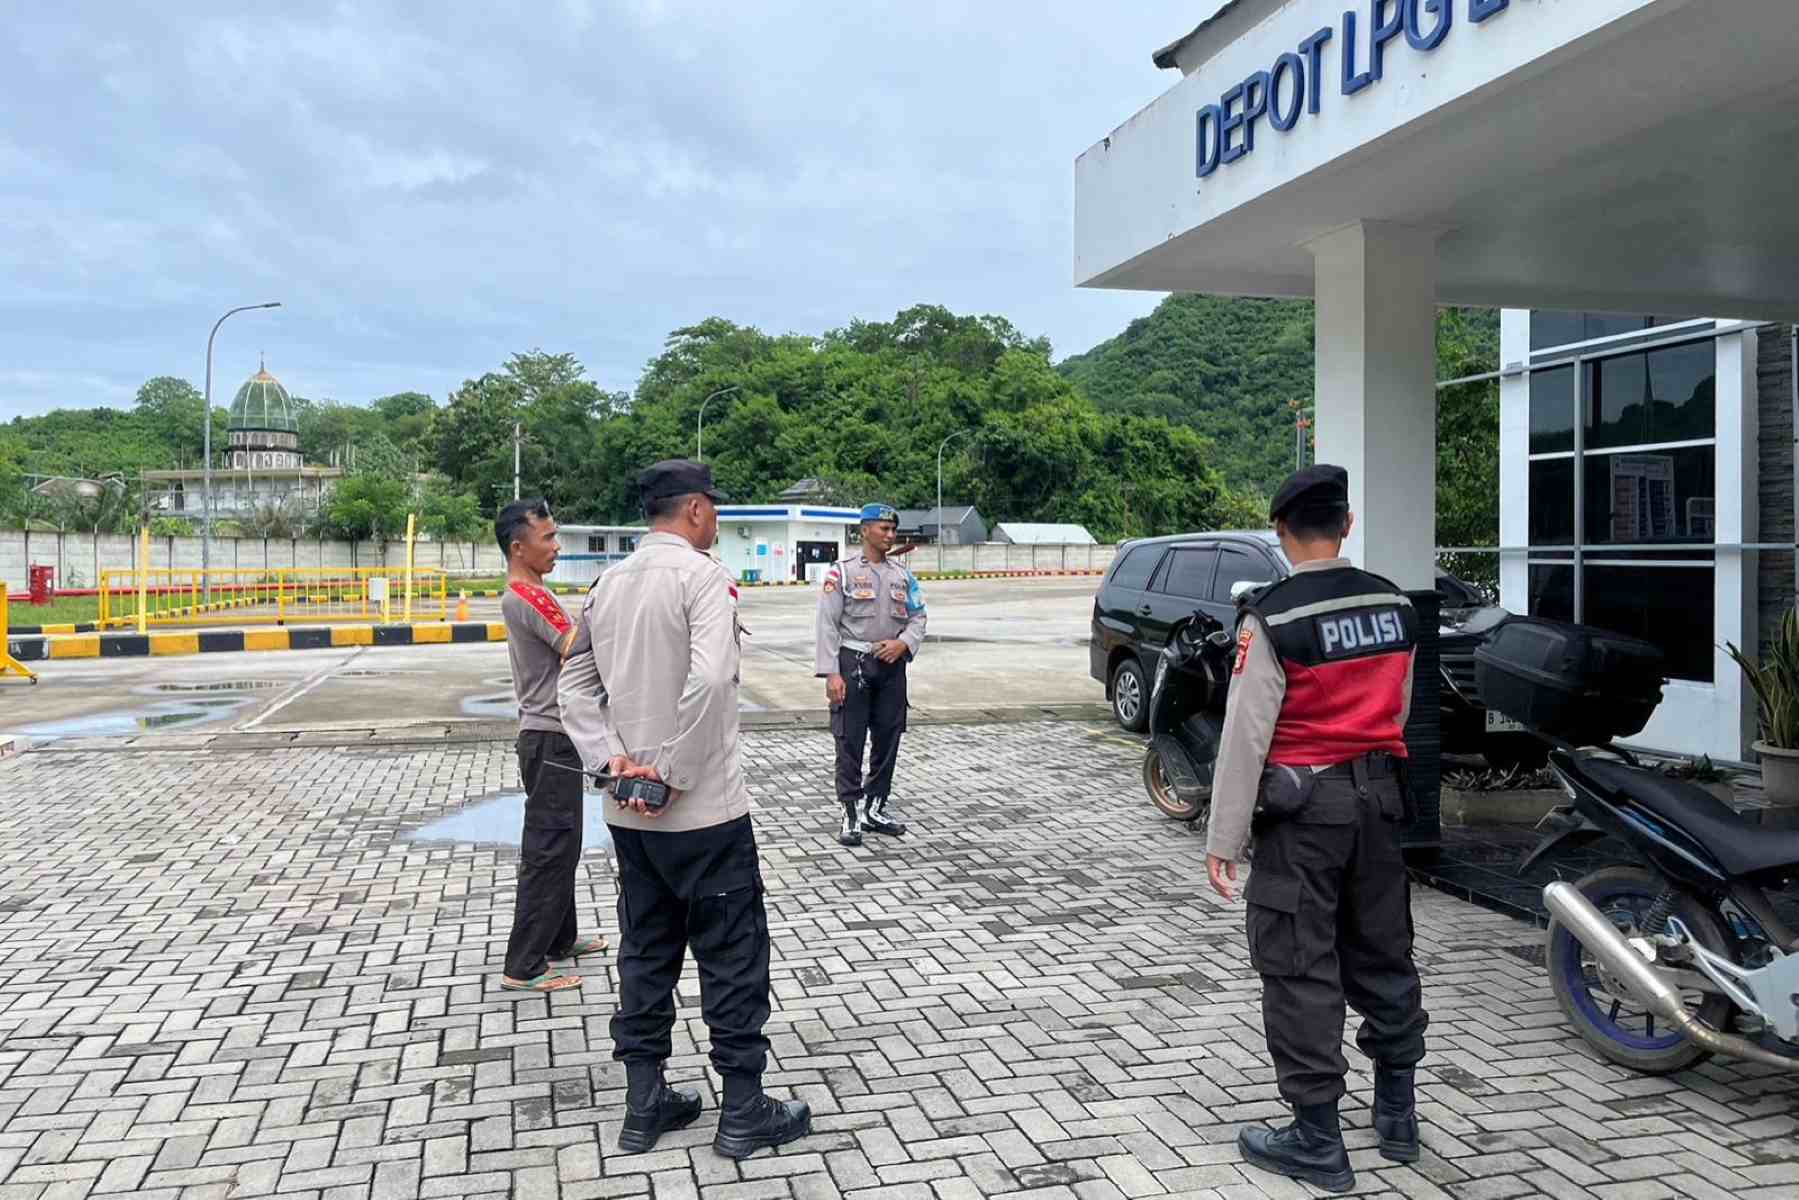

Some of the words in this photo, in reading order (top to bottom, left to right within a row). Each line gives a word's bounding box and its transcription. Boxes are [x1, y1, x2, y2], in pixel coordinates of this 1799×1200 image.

[1196, 27, 1333, 178] DEPOT
[1341, 0, 1453, 95] LPG
[1321, 611, 1404, 653] POLISI
